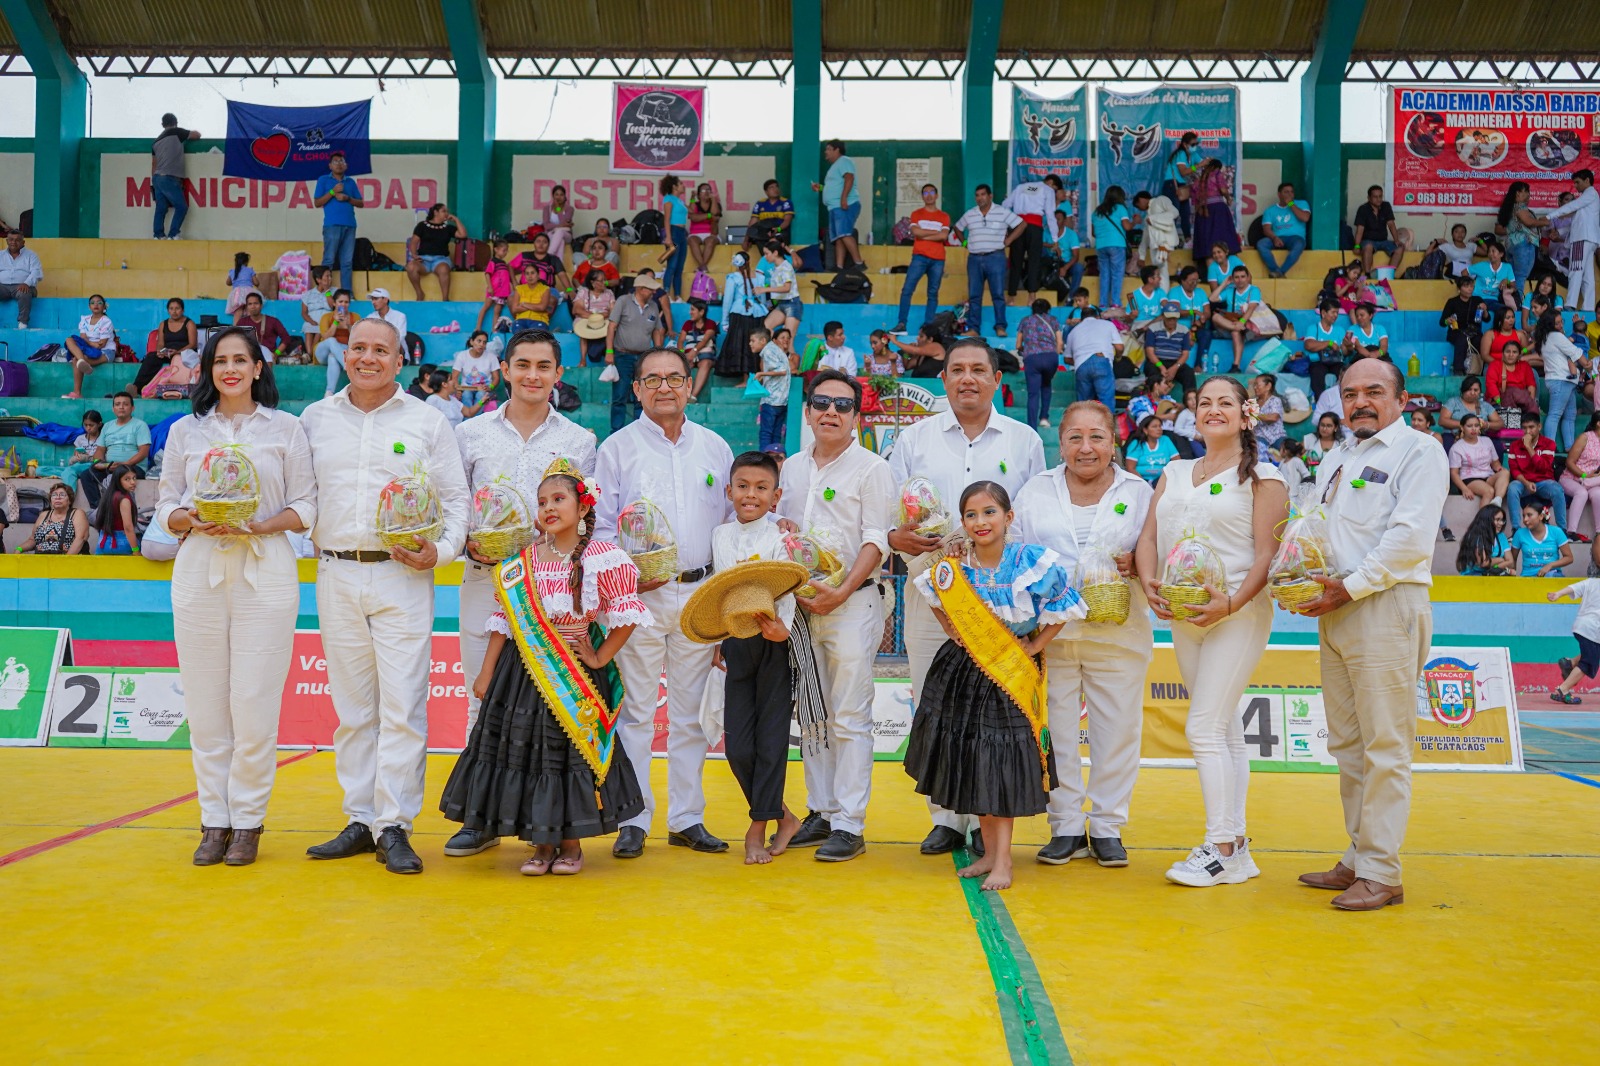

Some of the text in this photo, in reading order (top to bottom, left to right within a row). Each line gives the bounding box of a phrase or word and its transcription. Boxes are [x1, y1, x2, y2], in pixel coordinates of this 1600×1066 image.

[1176, 91, 1230, 104] Marinera
[1401, 91, 1493, 112] ACADEMIA
[1494, 92, 1549, 113] AISSA
[1446, 114, 1586, 129] MARINERA Y TONDERO
[625, 122, 692, 136] Inspiración
[297, 142, 331, 151] Tradición
[634, 134, 686, 147] Norteña
[292, 153, 303, 161] EL
[126, 176, 438, 210] MNICIPADAD
[906, 388, 931, 407] VILLA
[1428, 671, 1469, 679] CATACAOS
[57, 674, 101, 734] 2
[1241, 697, 1279, 758] 4
[1415, 735, 1505, 744] ICIPALIDAD DISTRITAL
[1421, 743, 1486, 751] DE CATACAOS
